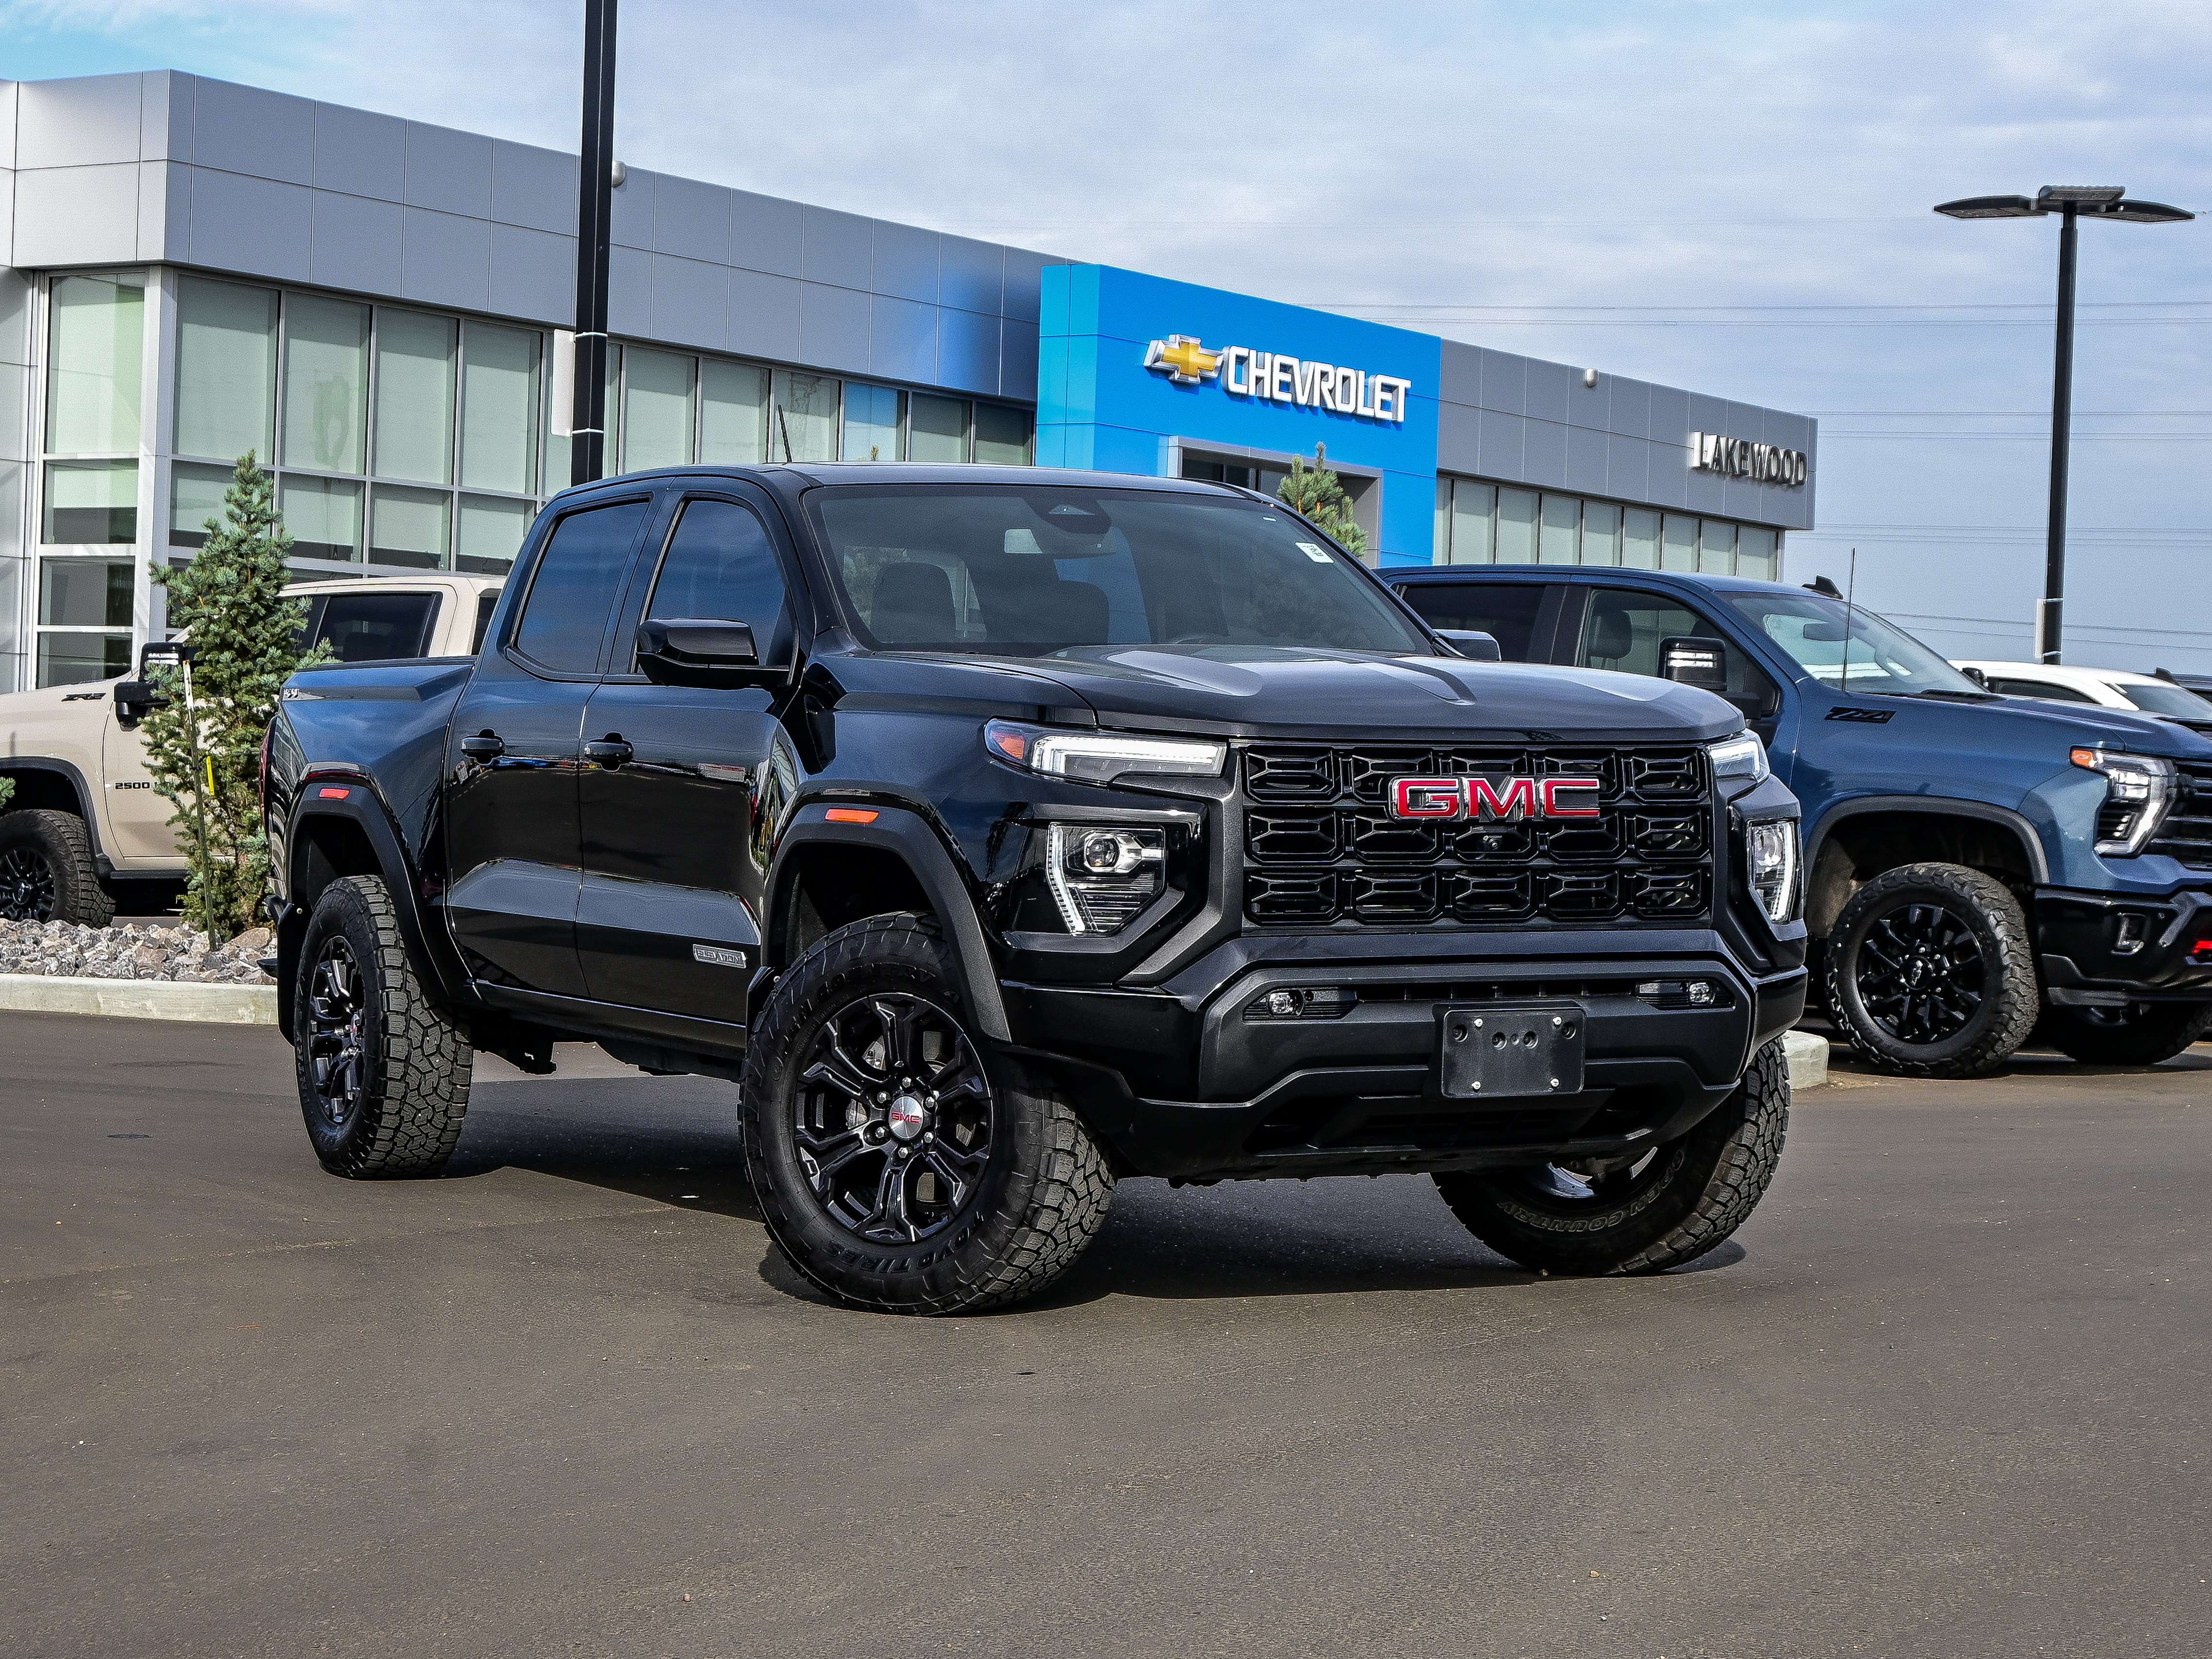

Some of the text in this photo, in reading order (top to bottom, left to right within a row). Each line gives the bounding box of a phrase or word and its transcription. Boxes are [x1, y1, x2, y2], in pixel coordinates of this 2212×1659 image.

[1221, 345, 1412, 423] CHEVROLET
[1689, 430, 1808, 486] LAKEWOOD
[115, 781, 150, 790] 2500
[1392, 777, 1601, 819] GMC
[696, 948, 743, 963] ELEVATION
[891, 1112, 921, 1125] GMC
[1496, 1149, 1685, 1232] OPEN COUNTRY
[822, 1240, 912, 1274] TIRES
